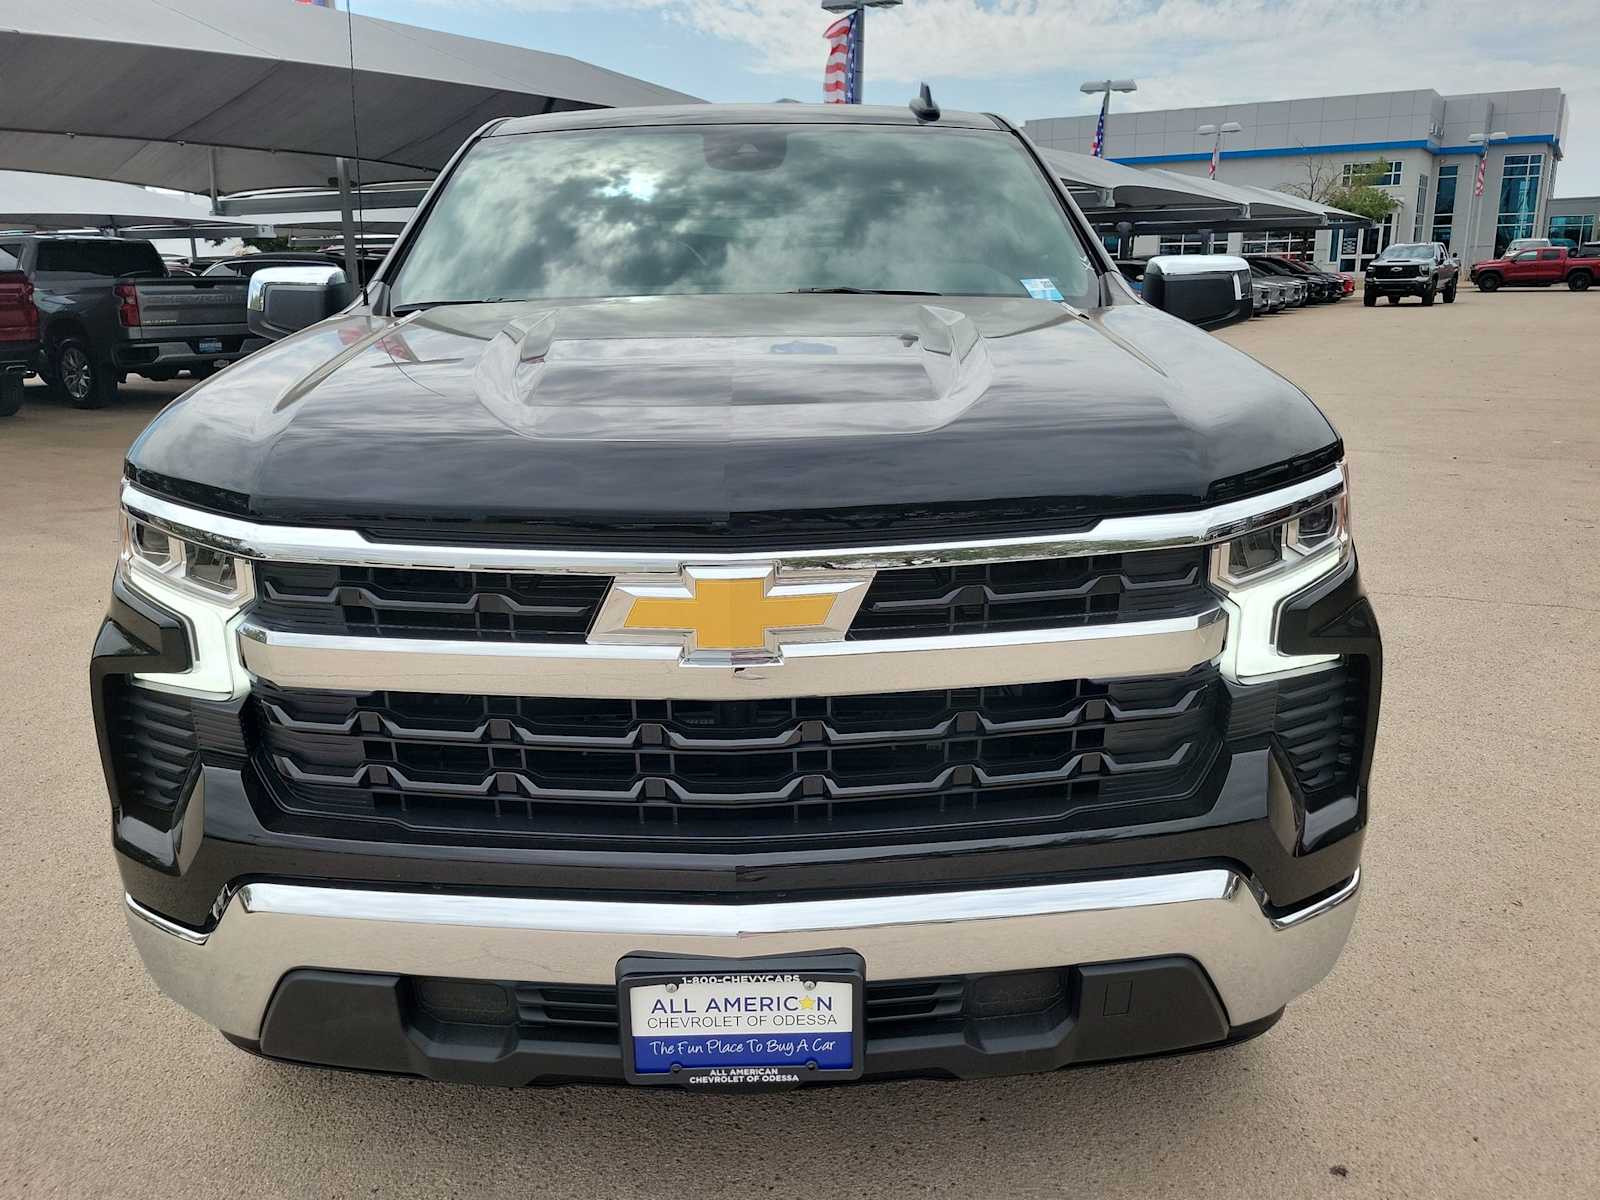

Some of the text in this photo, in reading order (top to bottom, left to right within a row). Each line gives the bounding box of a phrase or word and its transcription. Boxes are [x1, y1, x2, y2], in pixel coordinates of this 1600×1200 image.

[651, 996, 833, 1014] ALL AMERICN
[647, 1014, 838, 1029] CHEVROLET OF ODESSA
[649, 1038, 836, 1057] The Fun Place To Buy A Car
[689, 1074, 800, 1084] CHEVROLET OF ODESSA
[709, 1068, 778, 1077] ALL AMERICAN
